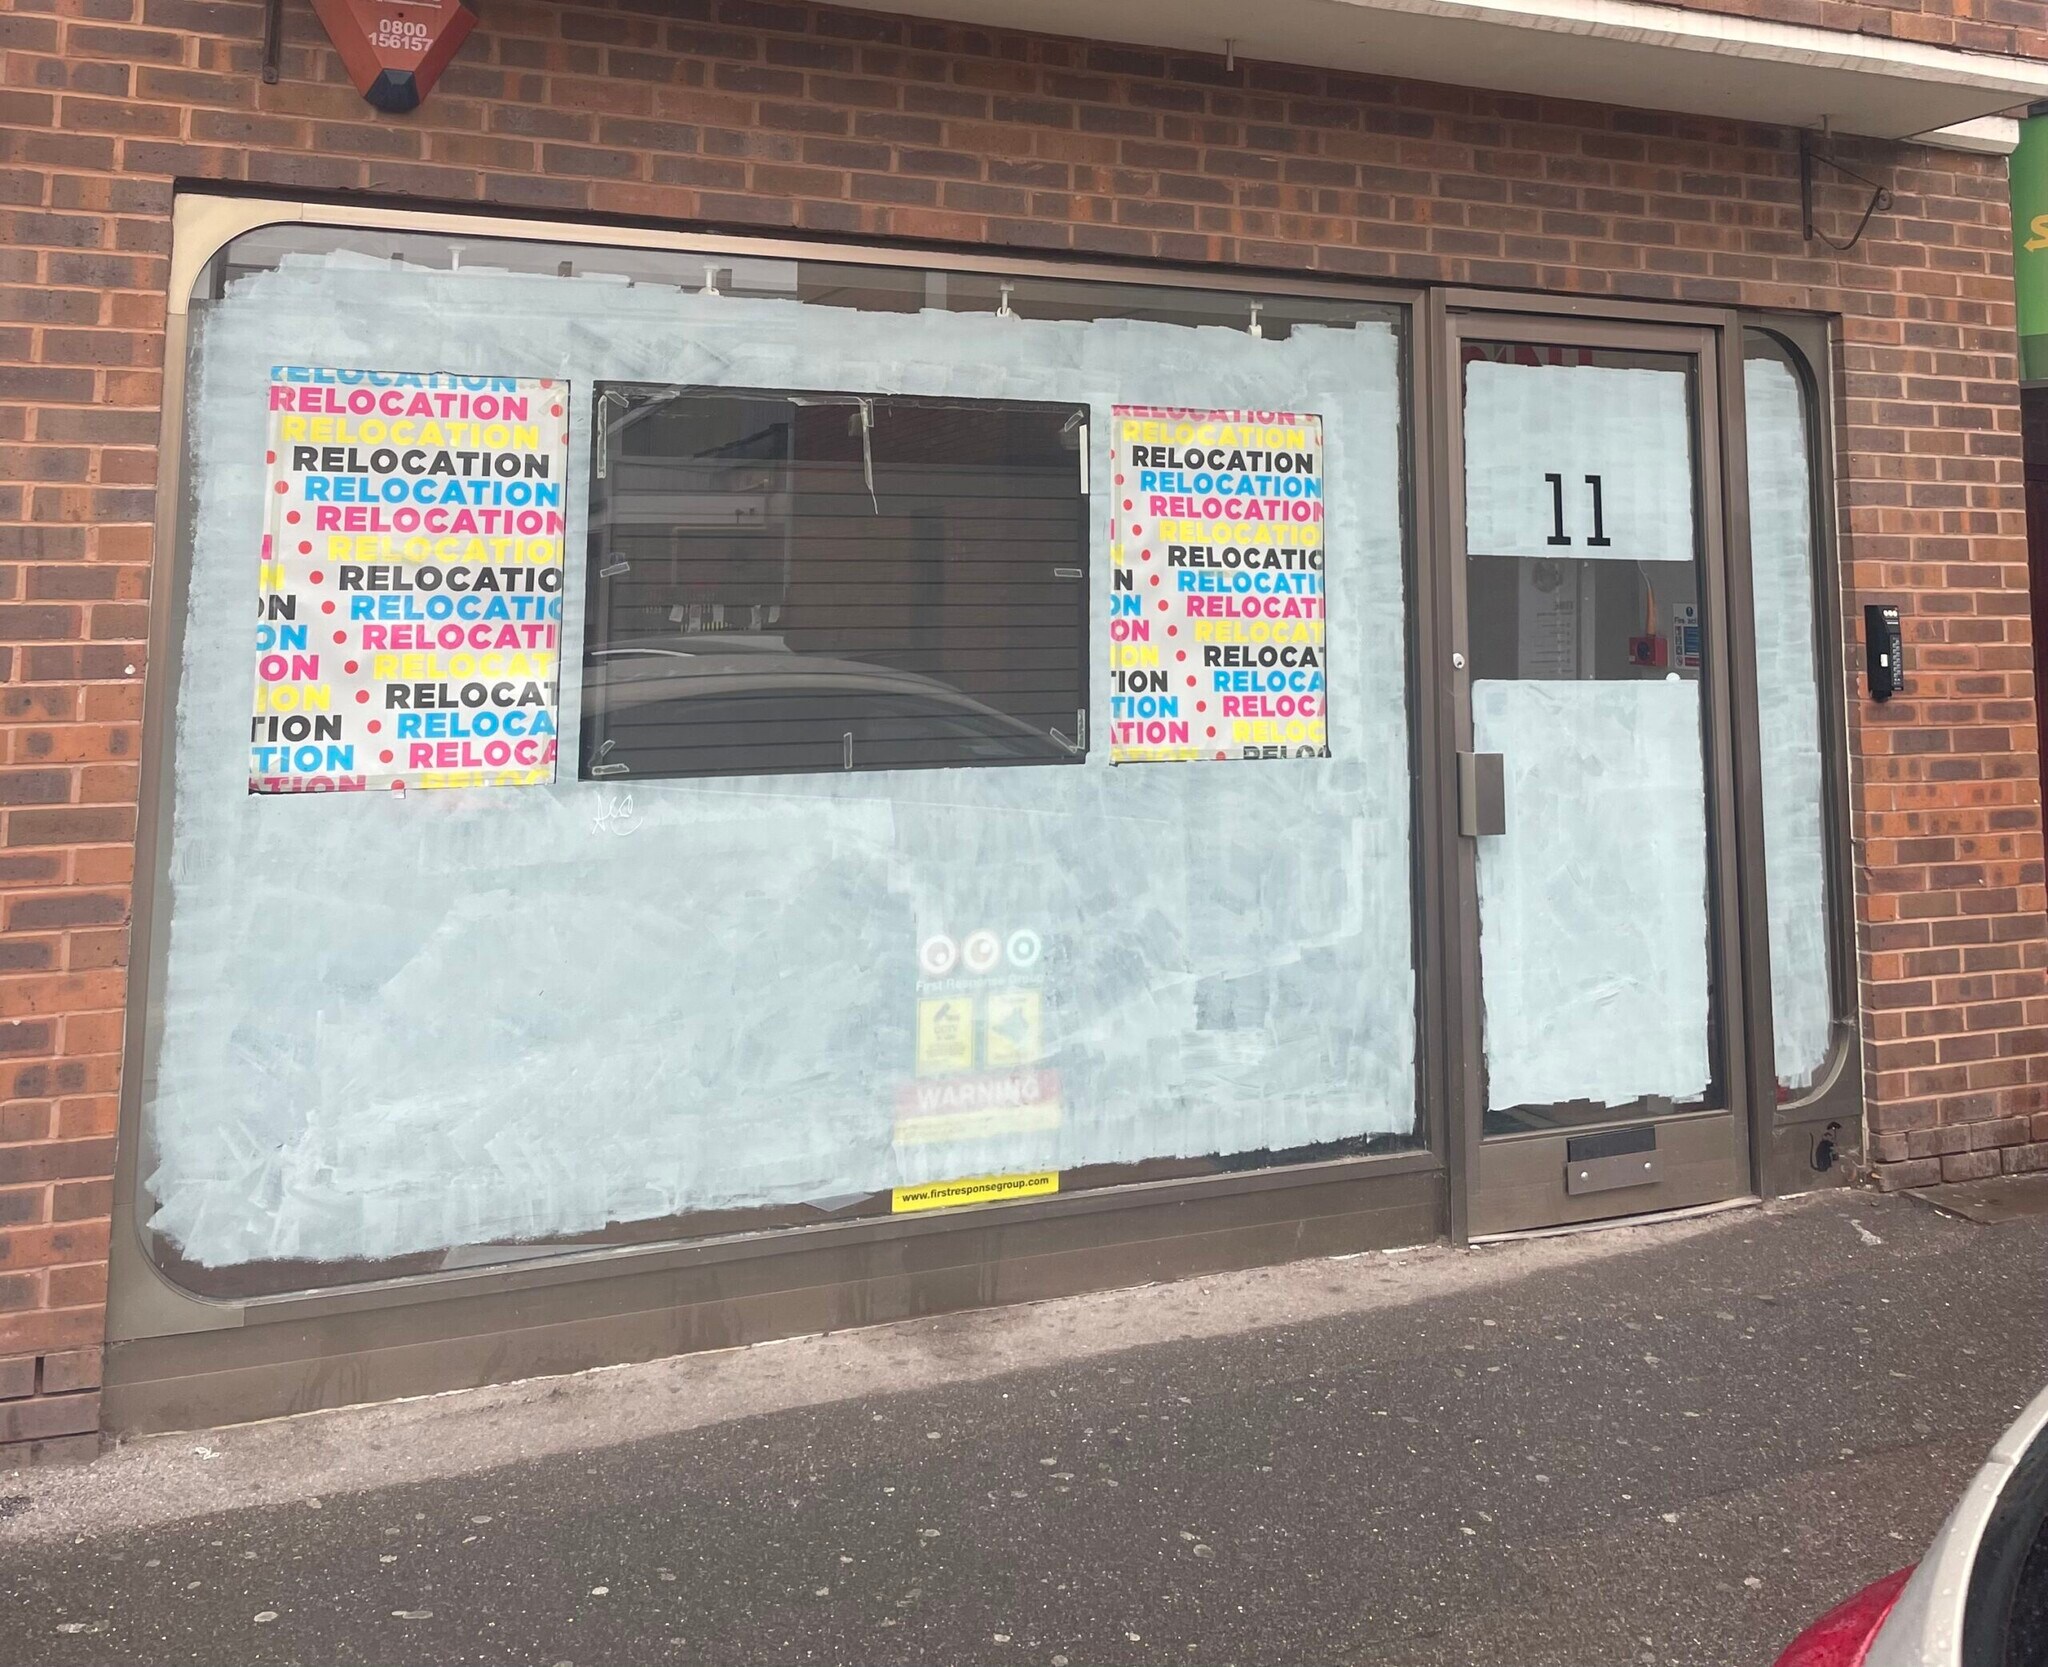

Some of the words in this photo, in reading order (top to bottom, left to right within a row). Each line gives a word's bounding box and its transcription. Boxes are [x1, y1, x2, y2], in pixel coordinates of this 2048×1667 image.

[368, 32, 435, 51] 156157
[379, 19, 427, 38] 0800
[269, 385, 528, 421] RELOCATION
[281, 415, 539, 450] RELOCATION
[1123, 420, 1306, 450] RELOCATION
[293, 446, 549, 479] RELOCATION
[1132, 445, 1313, 474] RELOCATION
[305, 476, 560, 507] RELOCATION
[1140, 470, 1321, 498] RELOCATION
[316, 505, 564, 535] RELOCATION
[1545, 473, 1611, 547] 11
[1159, 520, 1320, 548] RELOCATIO
[327, 535, 563, 564] RELOCATIO
[1168, 545, 1323, 570] RELOCATIO
[339, 565, 562, 593] RELOCATIO
[1178, 569, 1323, 594] RELOCATI
[257, 594, 296, 620] N
[256, 624, 308, 651] ON
[362, 624, 555, 651] RELOCATI
[1110, 619, 1150, 641] ON
[259, 654, 319, 681] ON
[373, 652, 555, 681] RELOCAT
[1203, 645, 1324, 668] RELOCA
[1111, 670, 1168, 693] ION
[1213, 670, 1324, 692] RELOCA
[1111, 695, 1179, 718] TION
[397, 710, 556, 739] RELOCA
[251, 744, 354, 773] TION
[249, 775, 366, 793] TION
[902, 1177, 1049, 1202] www.firstresponsegroup.com
